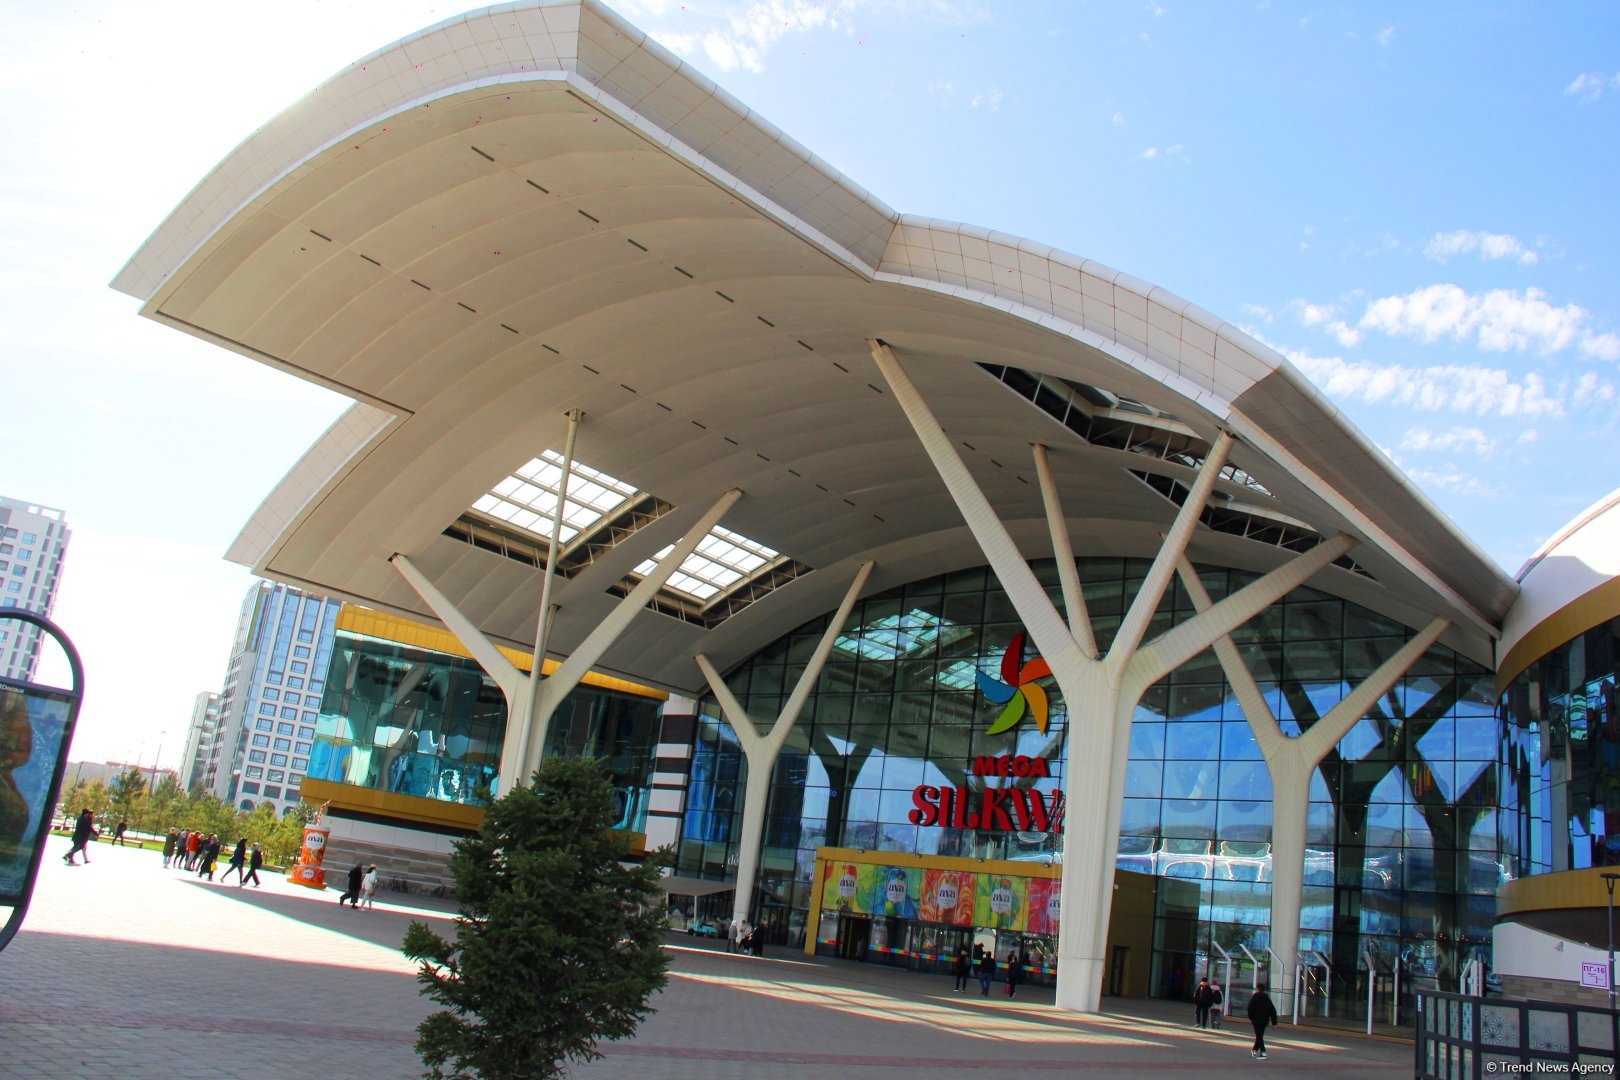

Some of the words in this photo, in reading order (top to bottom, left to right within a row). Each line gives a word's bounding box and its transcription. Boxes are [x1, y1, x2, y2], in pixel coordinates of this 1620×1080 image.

[973, 754, 1050, 778] MEGA
[306, 835, 323, 843] ava
[839, 879, 855, 888] ava
[888, 884, 905, 893] ava
[939, 889, 956, 898] ava
[992, 893, 1010, 903] ava
